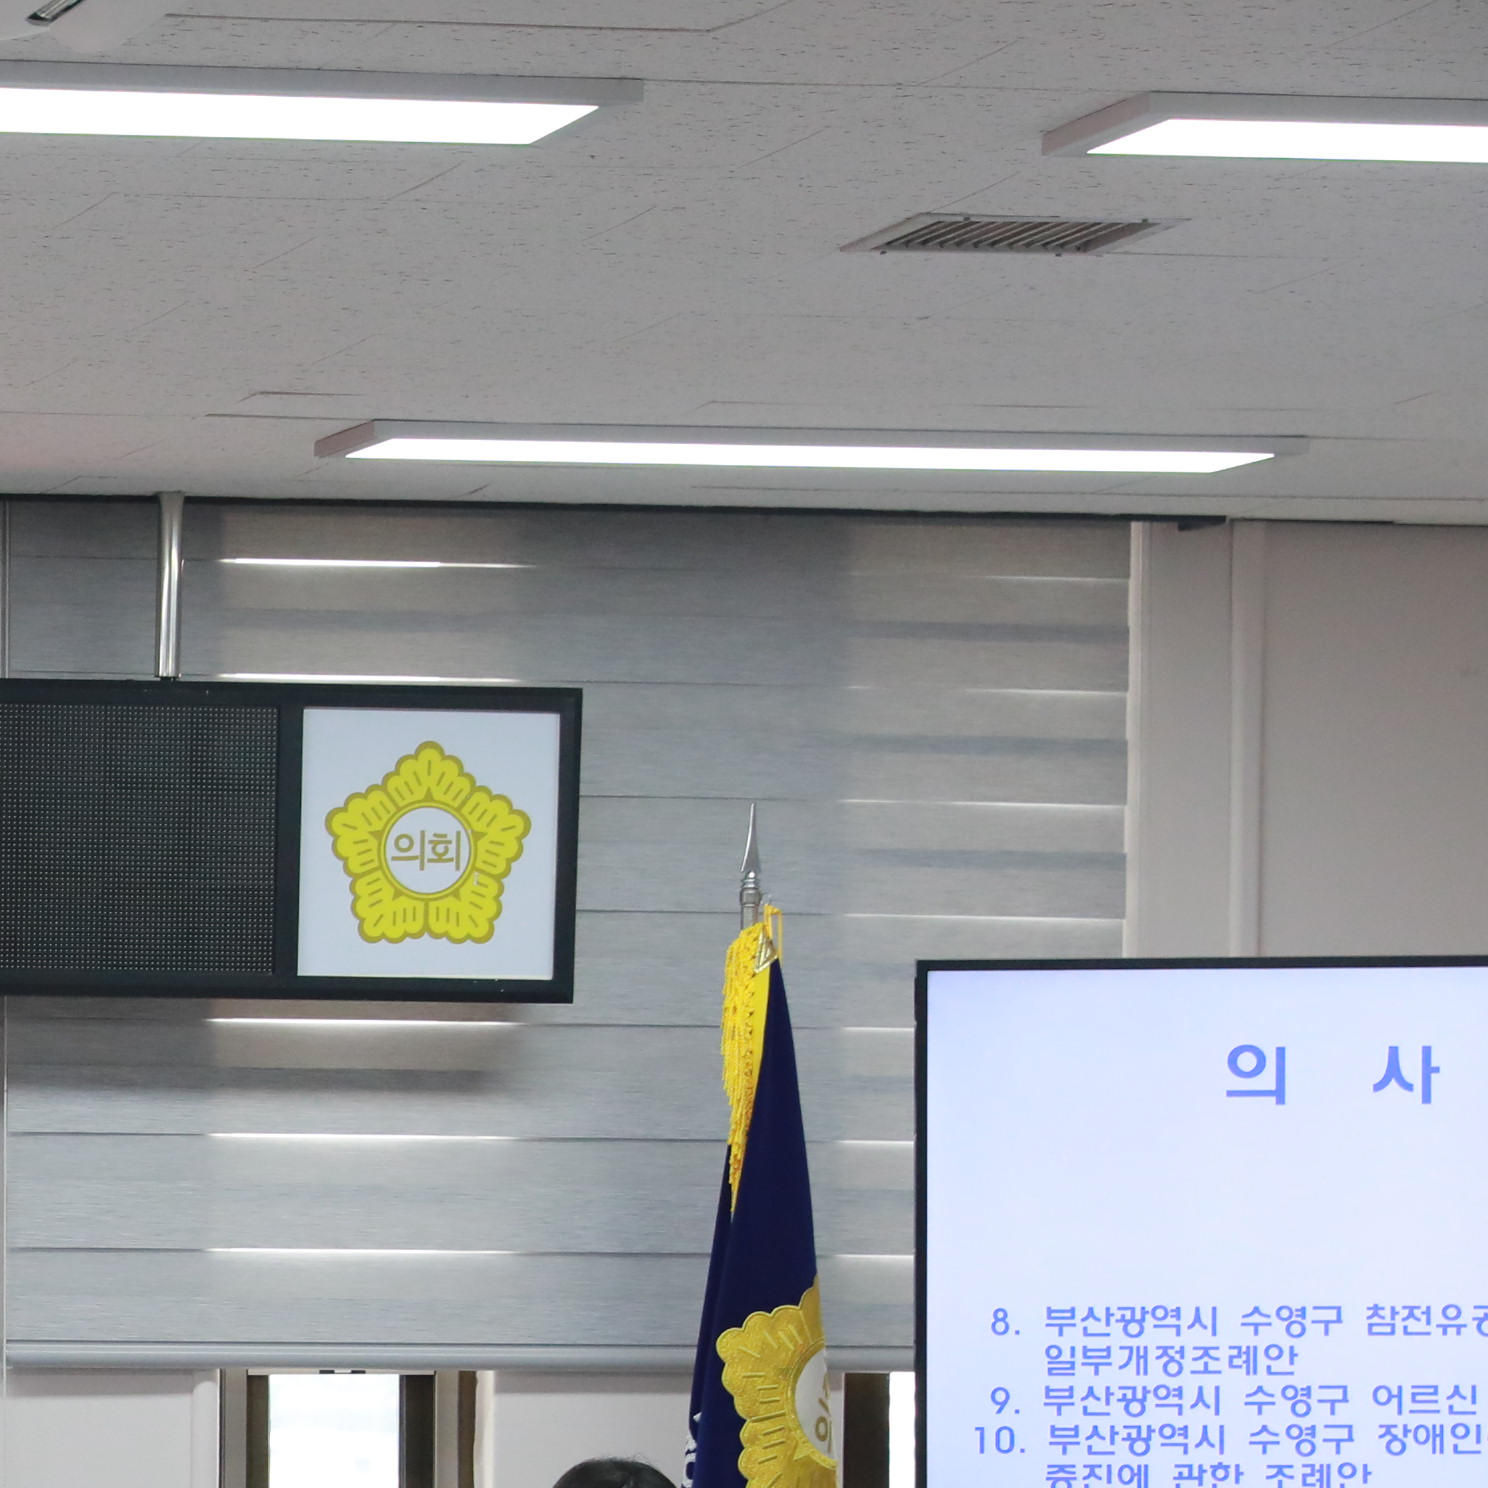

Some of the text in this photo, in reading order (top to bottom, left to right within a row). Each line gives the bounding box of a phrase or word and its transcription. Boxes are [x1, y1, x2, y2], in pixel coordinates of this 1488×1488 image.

[390, 829, 462, 872] 의회
[990, 1307, 1021, 1337] 8.
[1044, 1304, 1218, 1339] 부산광역시
[1240, 1304, 1344, 1339] 수영구
[1044, 1343, 1299, 1378] 일부개정조례안
[990, 1383, 1478, 1419] 9. 부산광역시 수영구 어르신
[974, 1422, 1488, 1458] 10. 부산광역시 수영구 장애인
